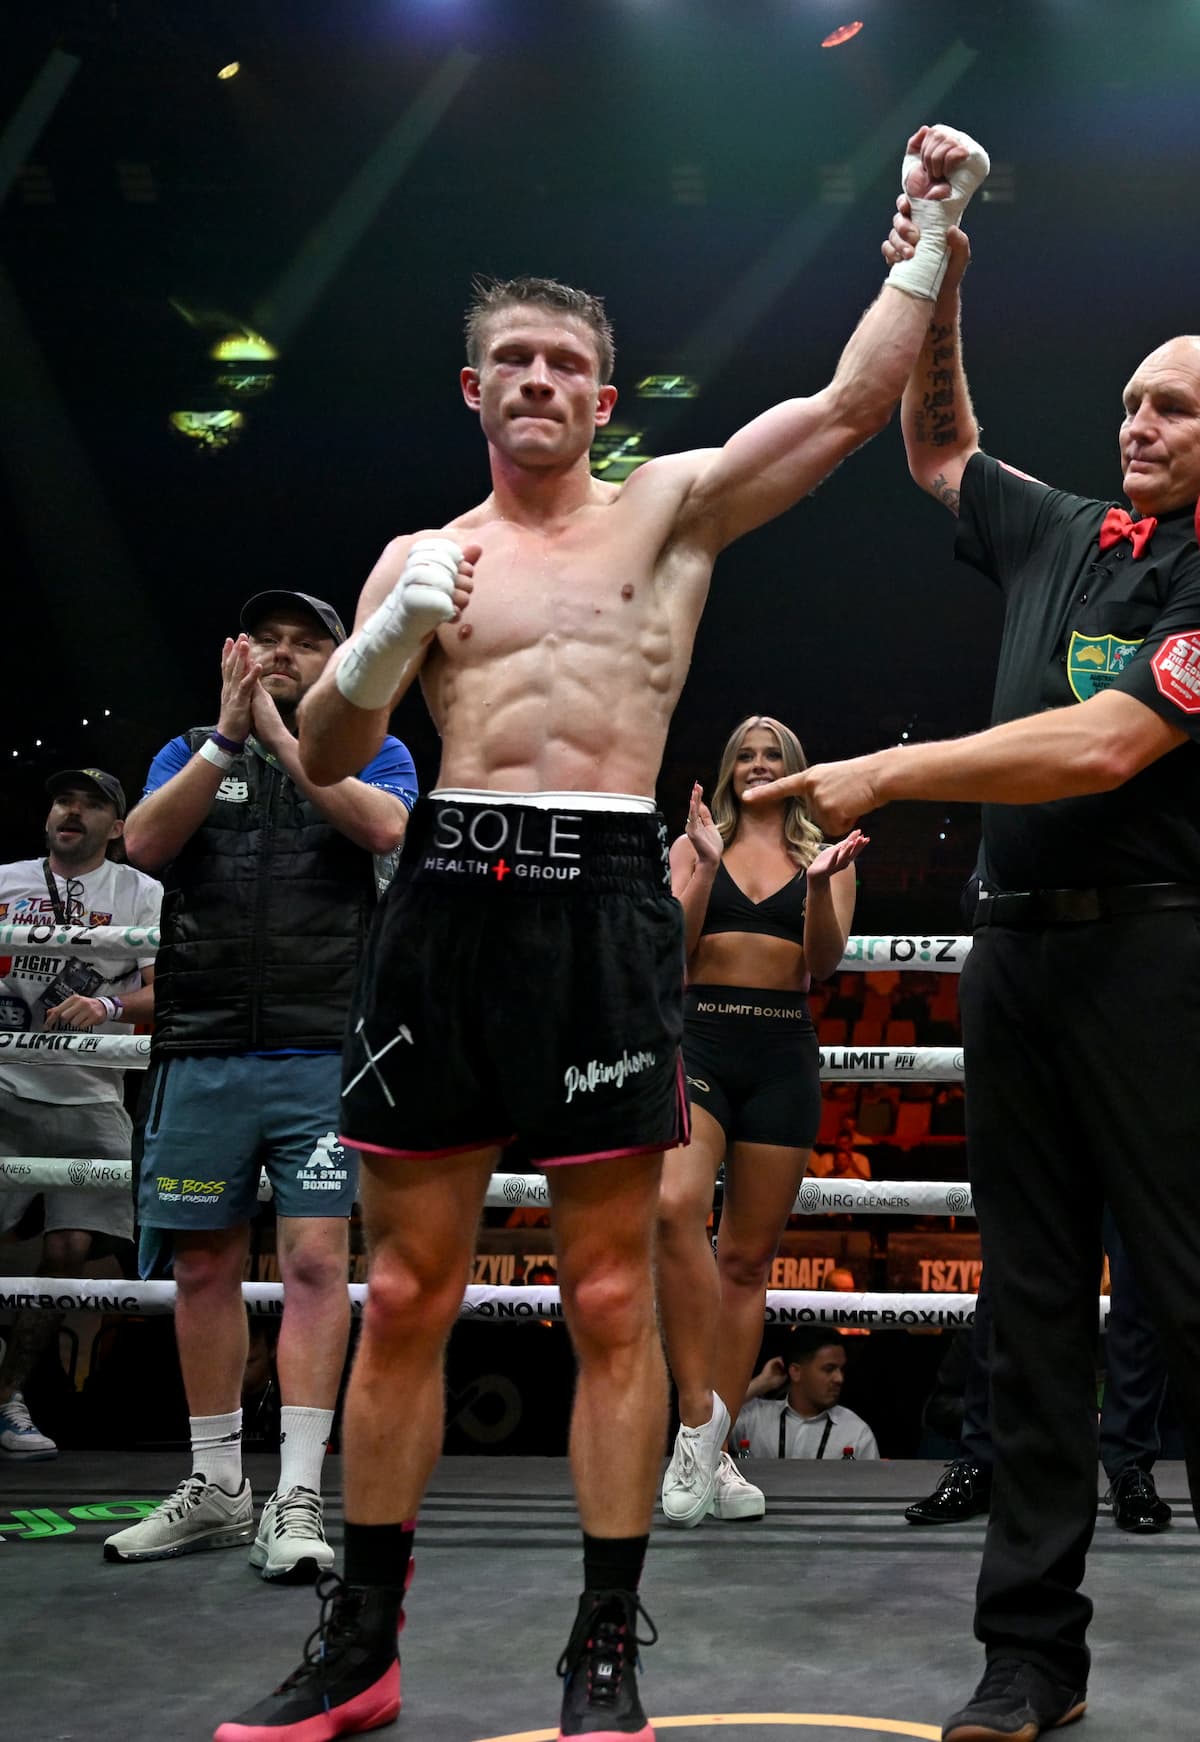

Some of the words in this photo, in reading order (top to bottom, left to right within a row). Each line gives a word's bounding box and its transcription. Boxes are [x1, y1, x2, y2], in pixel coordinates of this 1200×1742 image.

[1167, 652, 1184, 667] THE
[434, 808, 583, 859] SOLE
[425, 857, 488, 875] HEALTH
[514, 864, 581, 880] GROUP
[14, 955, 61, 972] FIGHT
[697, 1002, 716, 1012] NO
[718, 1004, 753, 1015] LIMIT
[754, 1007, 802, 1019] BOXING
[0, 1033, 13, 1048] O
[16, 1034, 78, 1051] LIMIT
[830, 1052, 890, 1070] LIMIT
[895, 1054, 916, 1069] PPV
[565, 1049, 656, 1103] Polkinghorn
[0, 1163, 31, 1175] ANERS
[90, 1166, 121, 1181] NRG
[297, 1170, 318, 1180] ALL
[319, 1170, 348, 1180] STAR
[156, 1176, 180, 1193] THE
[181, 1178, 227, 1195] BOSS
[302, 1180, 342, 1191] BOXING
[526, 1186, 547, 1200] NR
[822, 1194, 853, 1208] NRG
[856, 1196, 910, 1209] CLEANERS
[0, 1293, 38, 1310] MIT
[39, 1294, 140, 1312] BOXING
[499, 1302, 533, 1317] NO
[780, 1307, 816, 1323] NO
[822, 1308, 880, 1323] LIMIT
